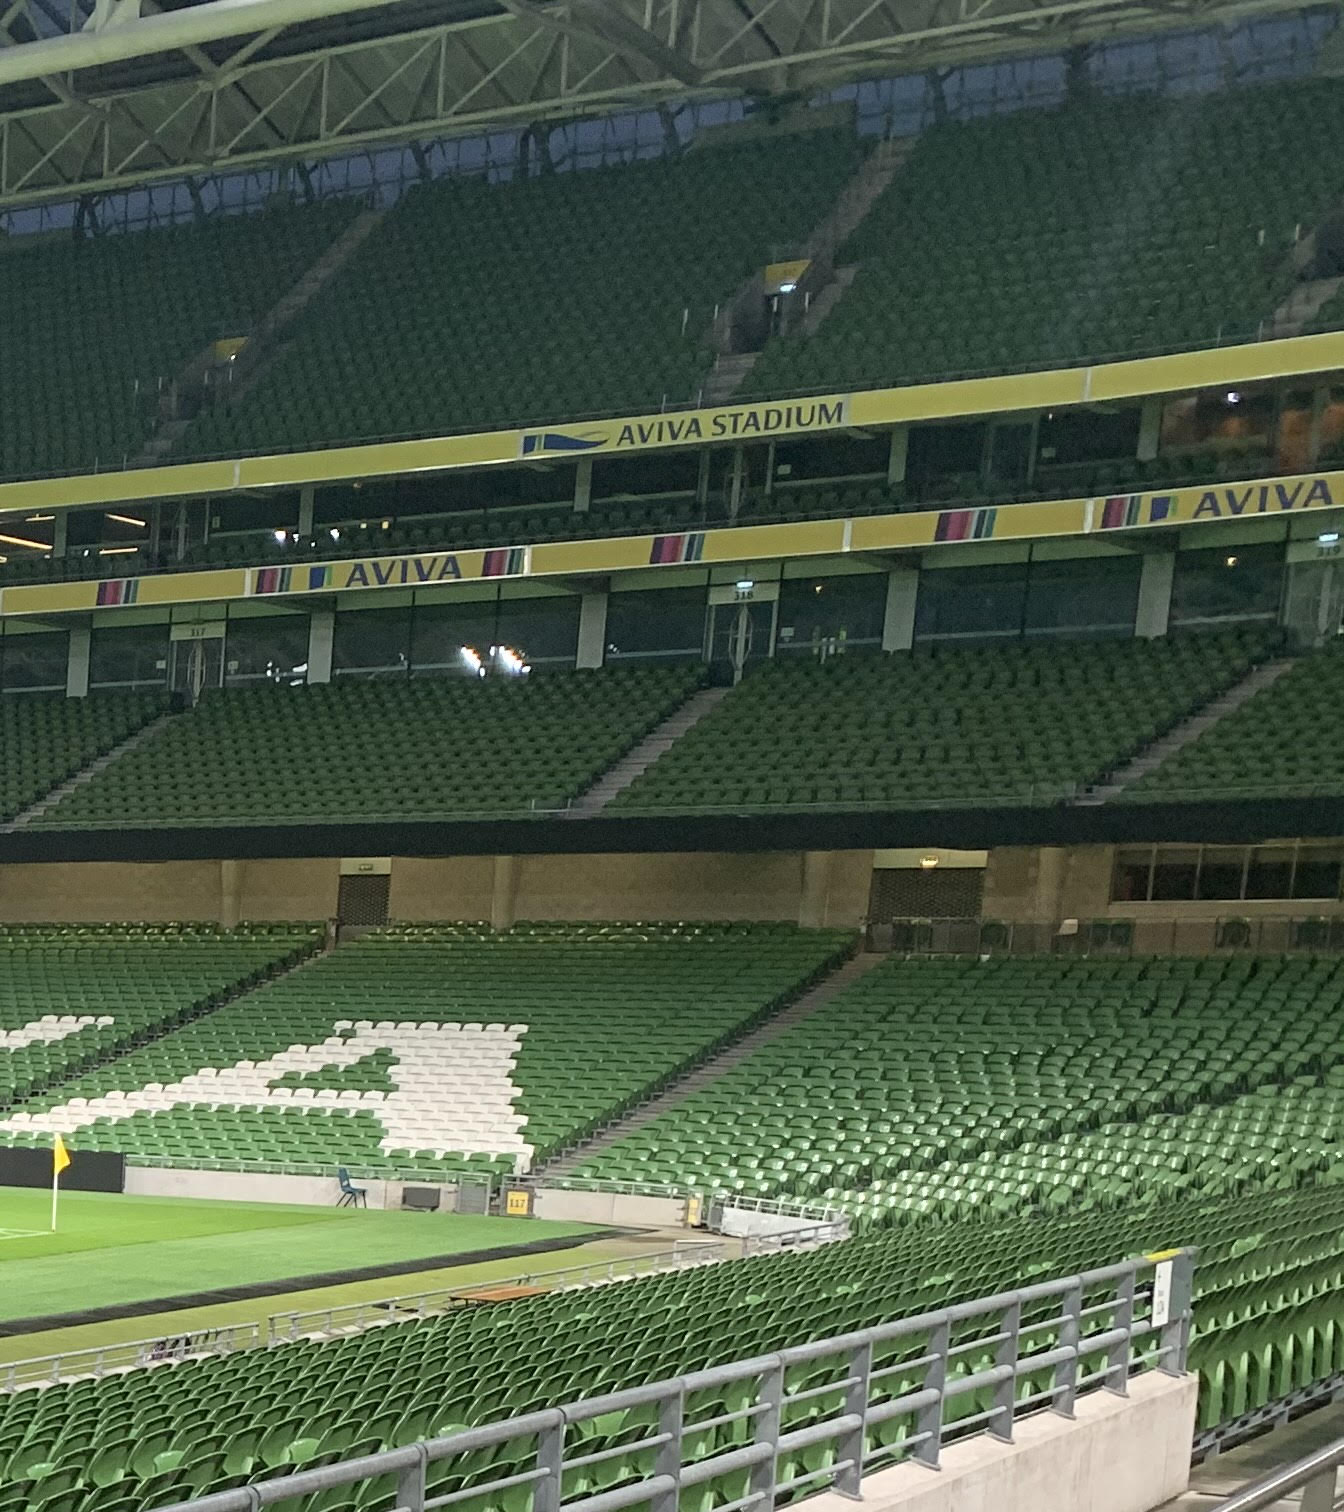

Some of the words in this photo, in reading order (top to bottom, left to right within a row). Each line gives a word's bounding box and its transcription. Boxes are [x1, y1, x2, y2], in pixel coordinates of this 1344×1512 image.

[616, 417, 703, 447] AVIVA
[711, 401, 844, 437] STADIUM
[1193, 479, 1333, 519] AVIVA
[345, 556, 462, 588] AVIVA
